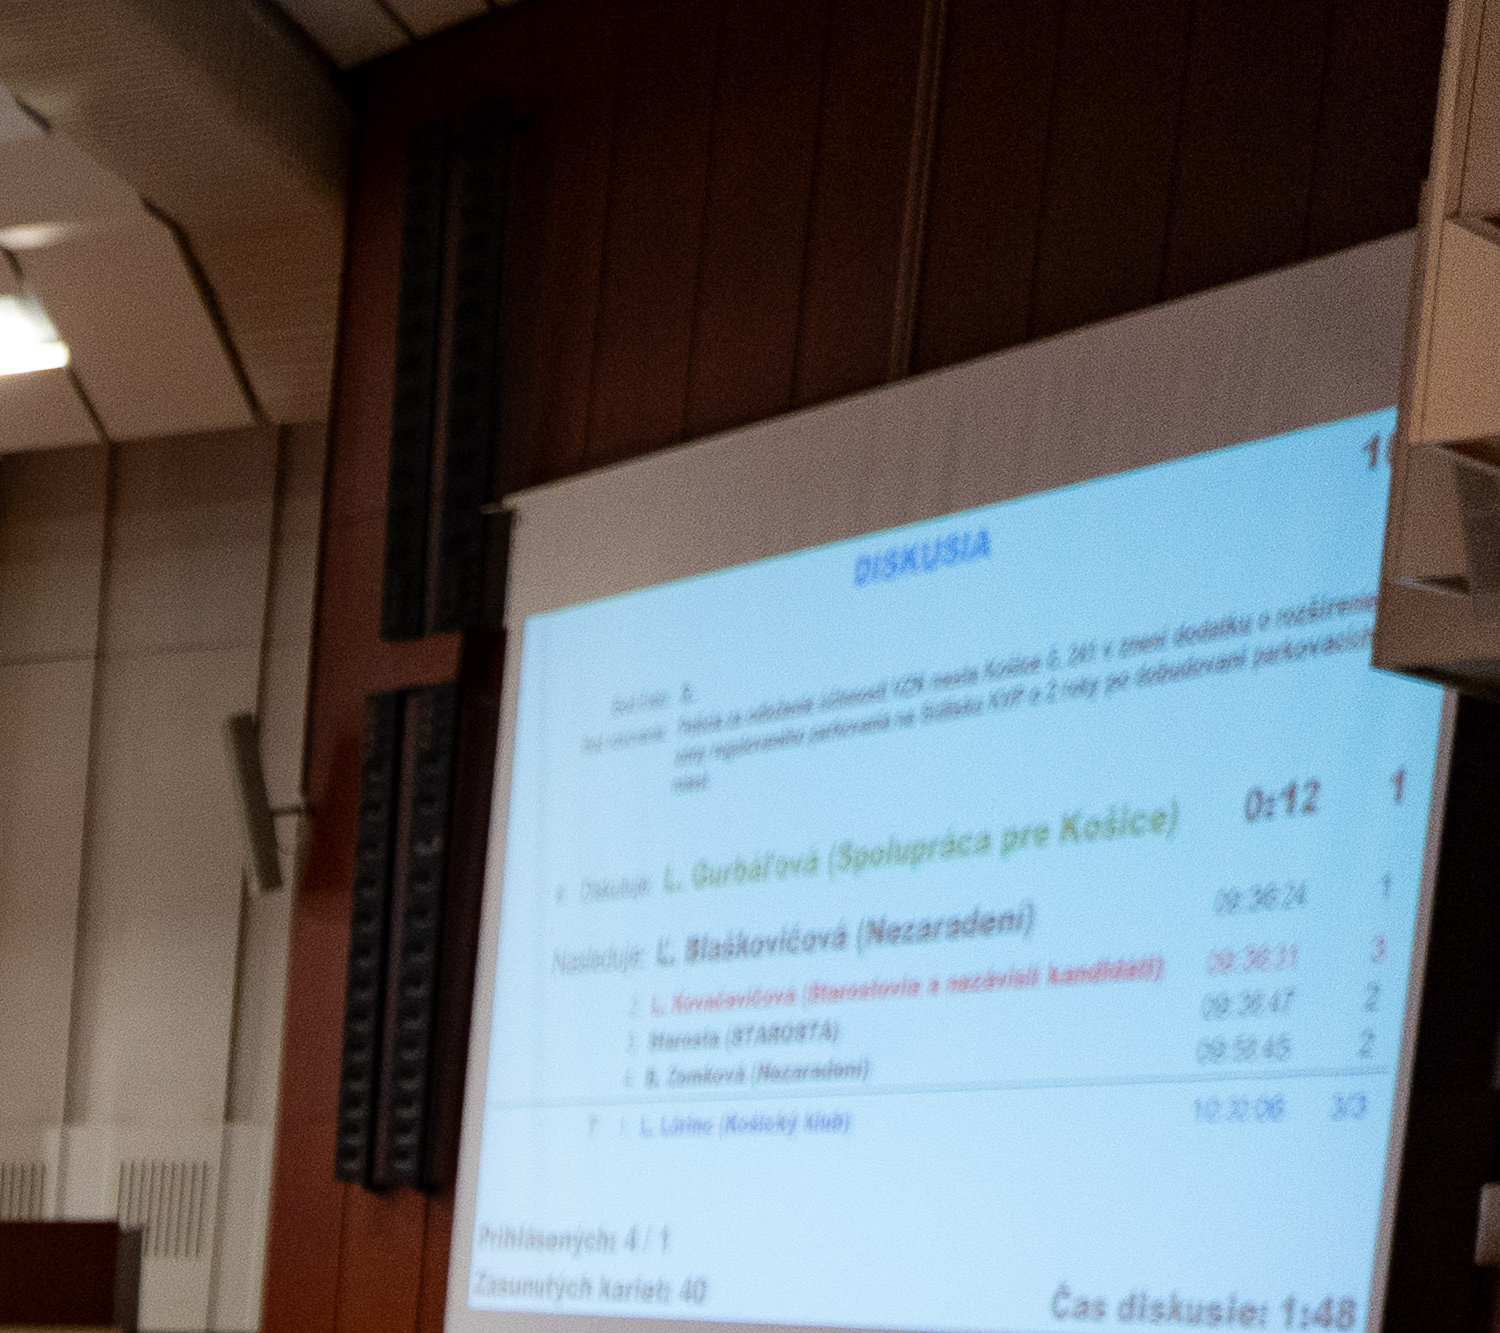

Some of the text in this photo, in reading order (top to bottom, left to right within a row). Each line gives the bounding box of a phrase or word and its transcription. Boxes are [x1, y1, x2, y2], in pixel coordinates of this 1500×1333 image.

[852, 527, 994, 588] DISKUSIA
[1000, 823, 1052, 861] pre
[1058, 797, 1183, 854] Košice)
[1240, 777, 1324, 825] 0:12
[1049, 1280, 1361, 1331] Čas diskusie: 1:48
